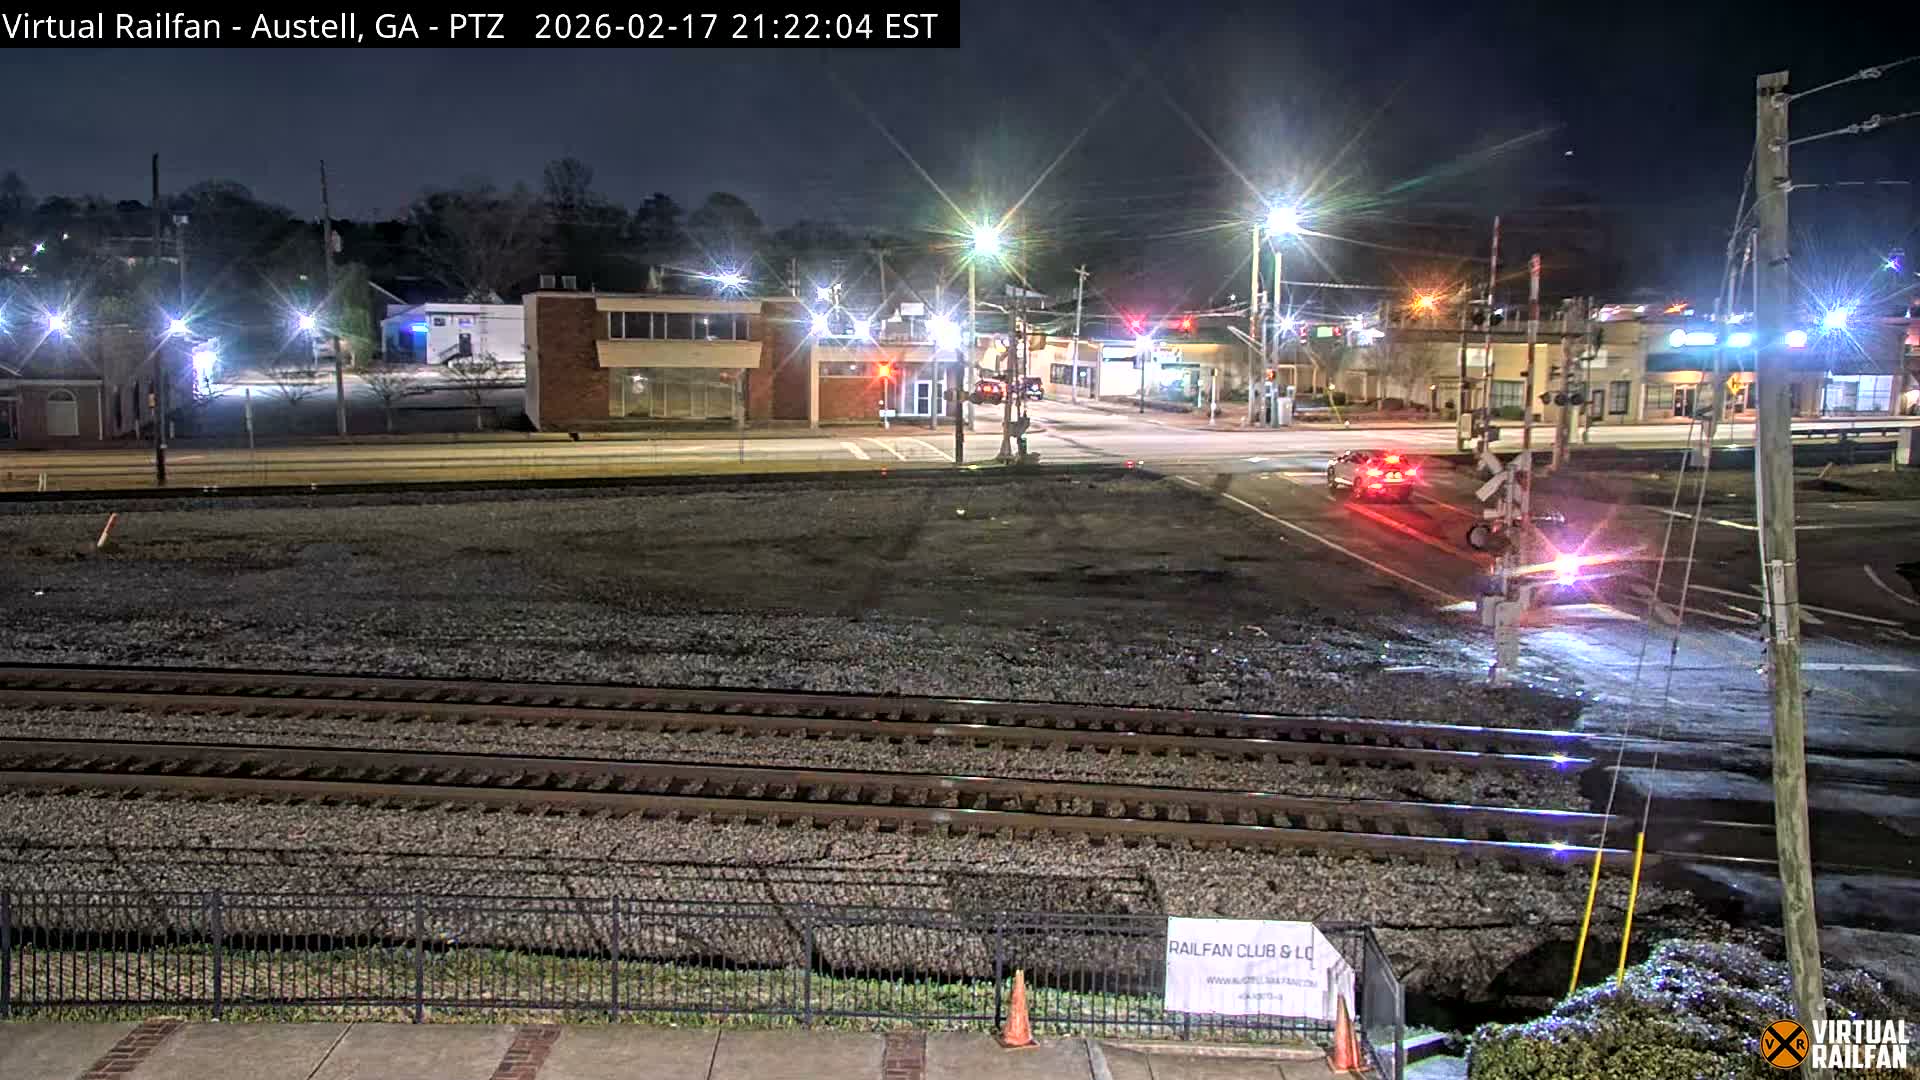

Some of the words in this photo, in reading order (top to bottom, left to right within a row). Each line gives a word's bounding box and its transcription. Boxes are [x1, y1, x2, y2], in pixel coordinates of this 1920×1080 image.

[1169, 940, 1233, 957] RAILFAN
[1237, 943, 1276, 958] CLUB
[1279, 944, 1292, 958] &
